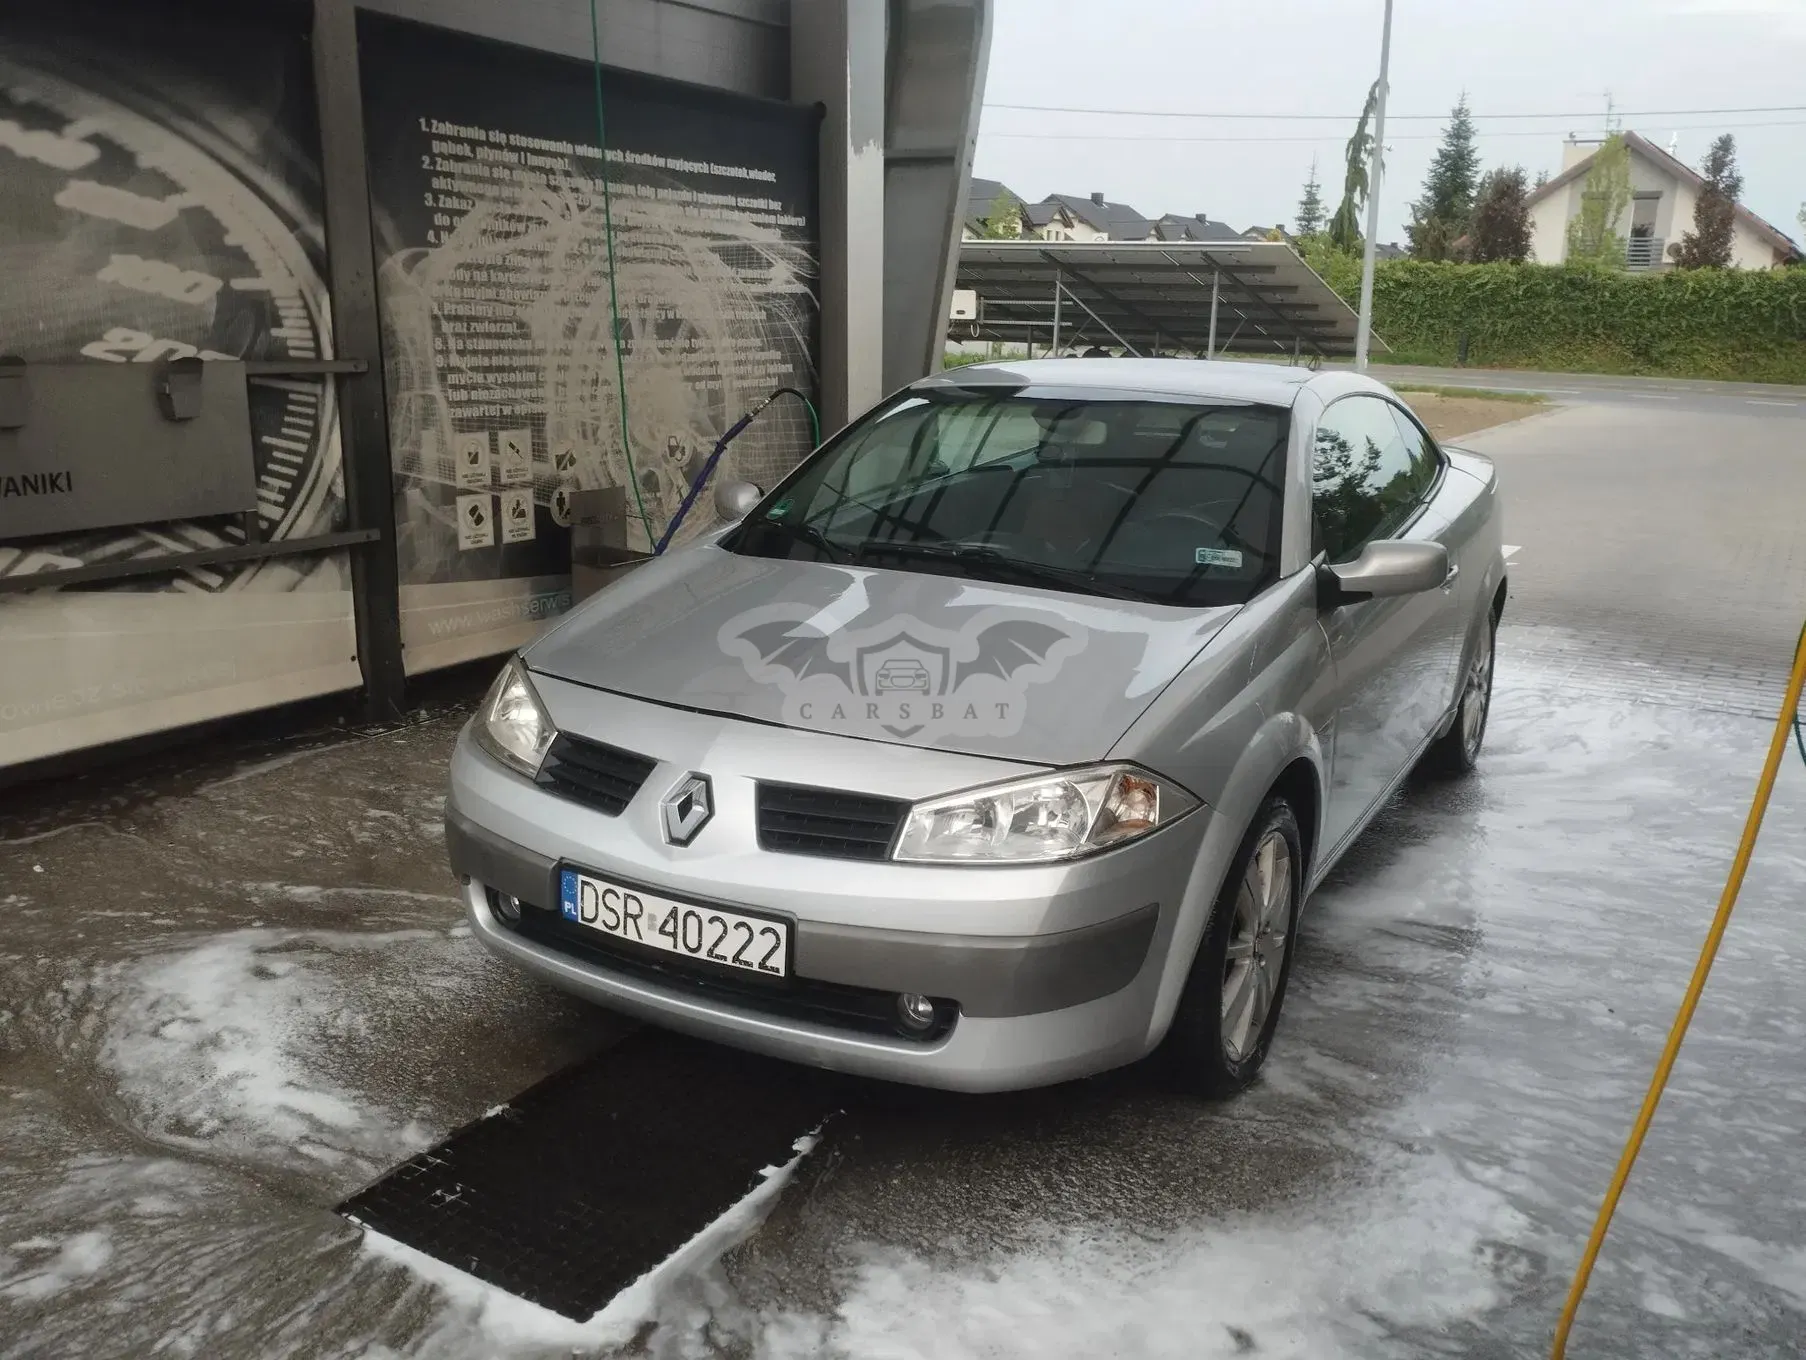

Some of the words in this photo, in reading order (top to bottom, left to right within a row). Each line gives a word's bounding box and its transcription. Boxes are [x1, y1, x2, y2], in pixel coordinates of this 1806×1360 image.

[431, 119, 486, 141] Zabrania
[0, 470, 73, 499] ANIKI
[564, 901, 577, 916] PL
[580, 879, 644, 941] DSR
[658, 906, 782, 974] 40222
